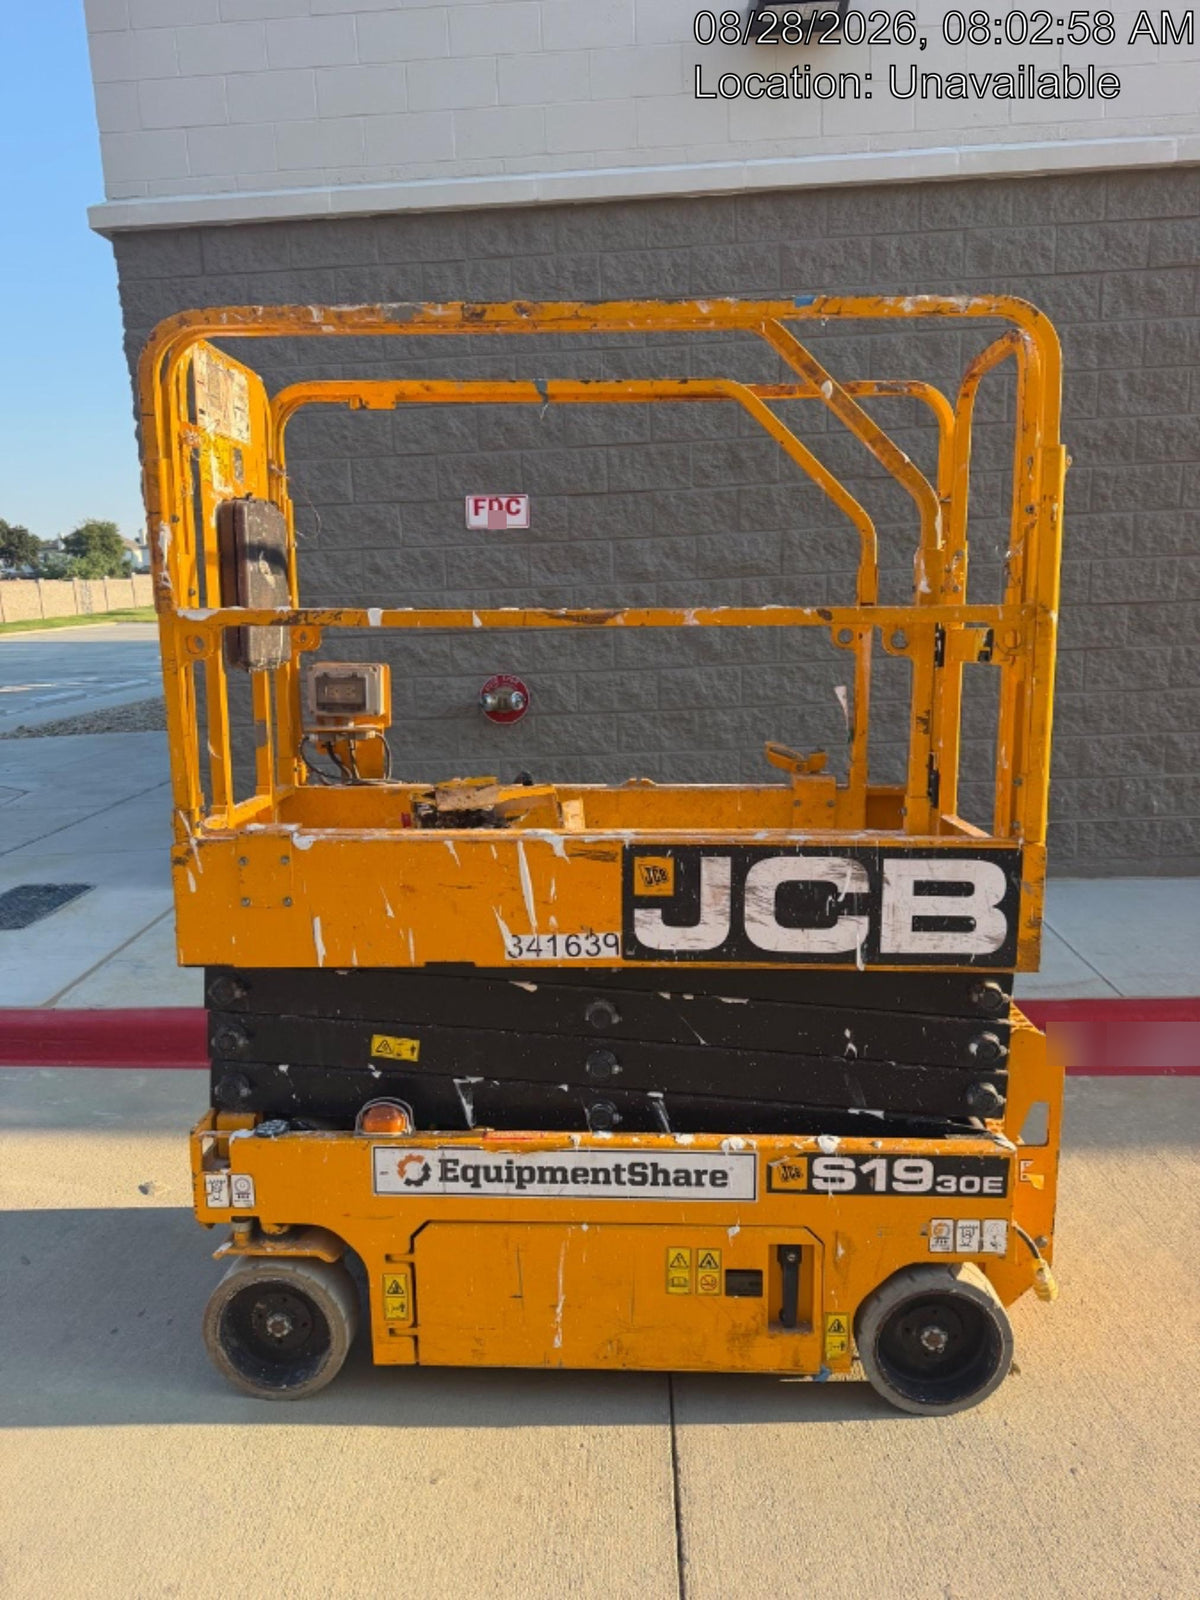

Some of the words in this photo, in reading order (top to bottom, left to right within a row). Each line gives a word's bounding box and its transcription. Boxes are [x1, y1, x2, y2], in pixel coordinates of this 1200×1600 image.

[643, 865, 669, 887] JCB
[634, 857, 1008, 954] JCB
[508, 932, 620, 958] 341639
[438, 1158, 728, 1189] EquipmentShare
